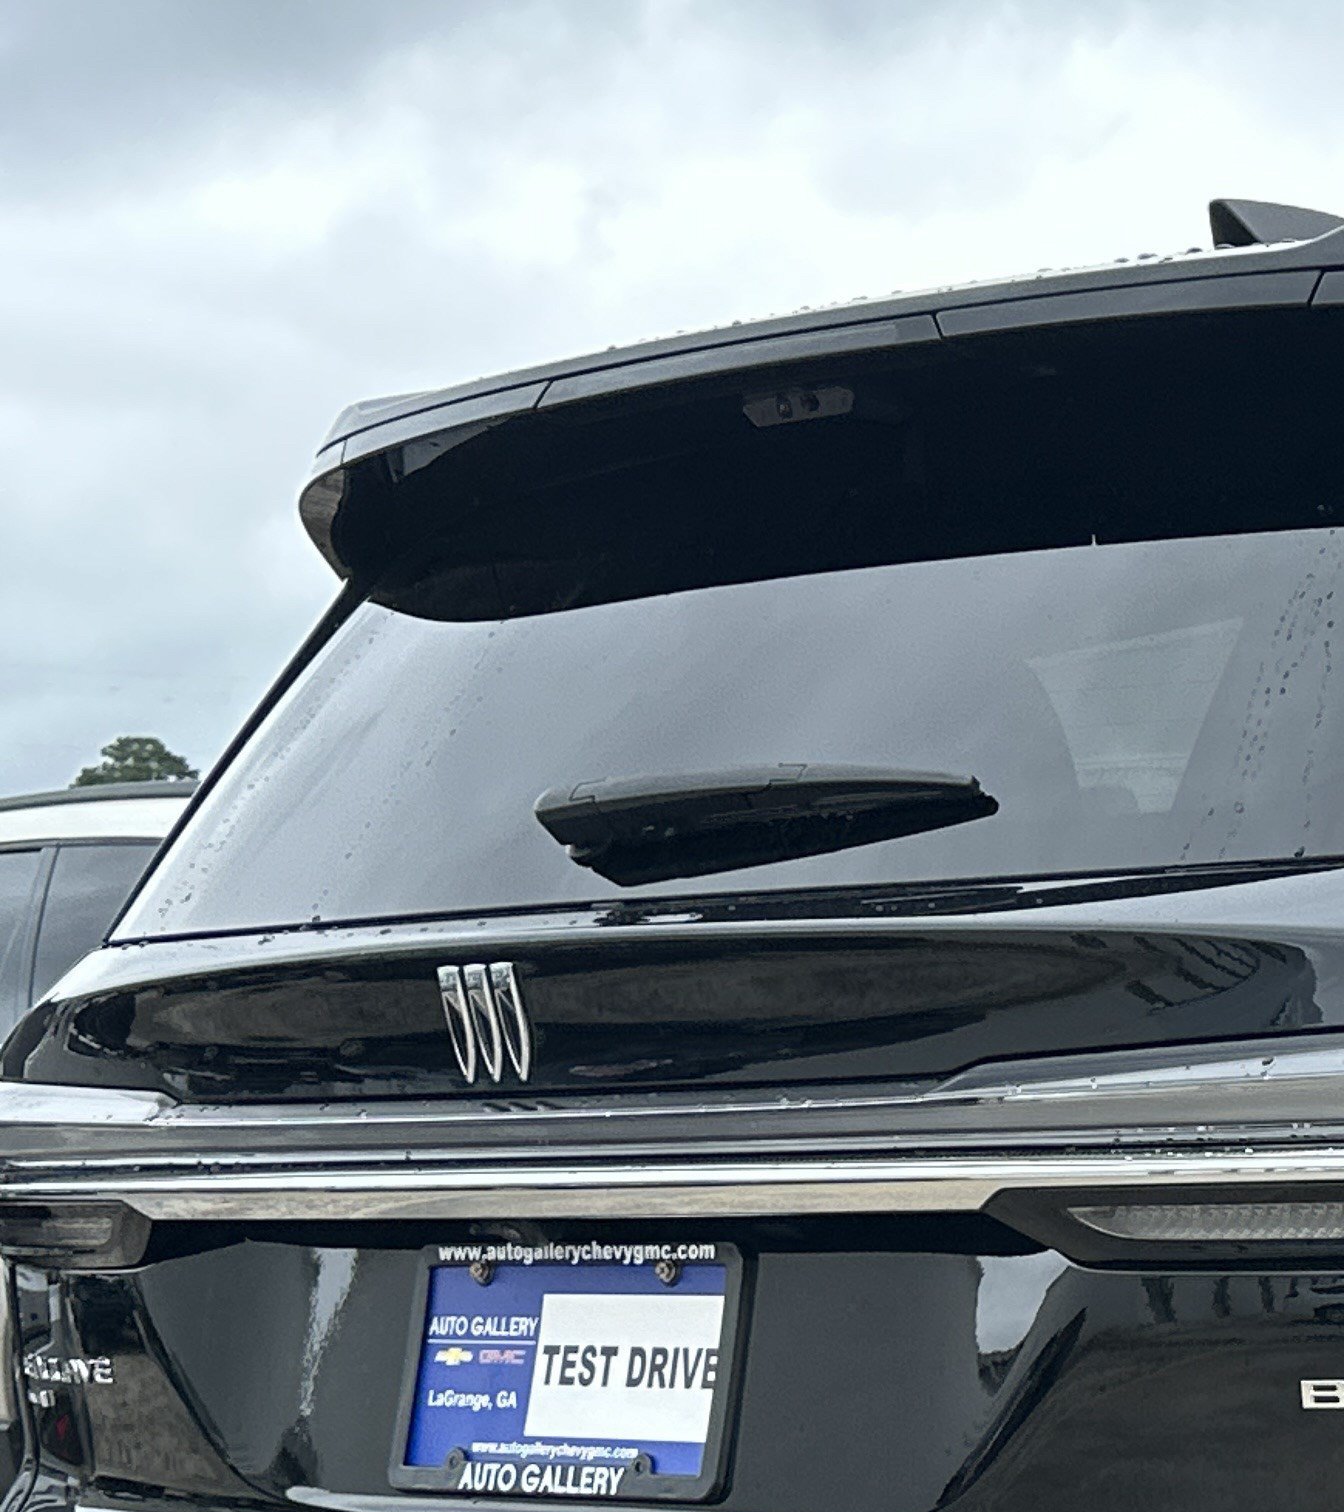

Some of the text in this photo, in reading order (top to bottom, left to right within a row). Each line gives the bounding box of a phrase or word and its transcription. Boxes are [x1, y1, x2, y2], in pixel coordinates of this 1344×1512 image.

[438, 1241, 715, 1265] www.autogallerychevygmc.com
[429, 1315, 539, 1337] AUTO GALLERY
[479, 1349, 526, 1365] GMC
[543, 1345, 719, 1390] TEST DRIVE
[428, 1389, 517, 1412] LaGrange, GA
[457, 1462, 625, 1496] AUTO GALLERY
